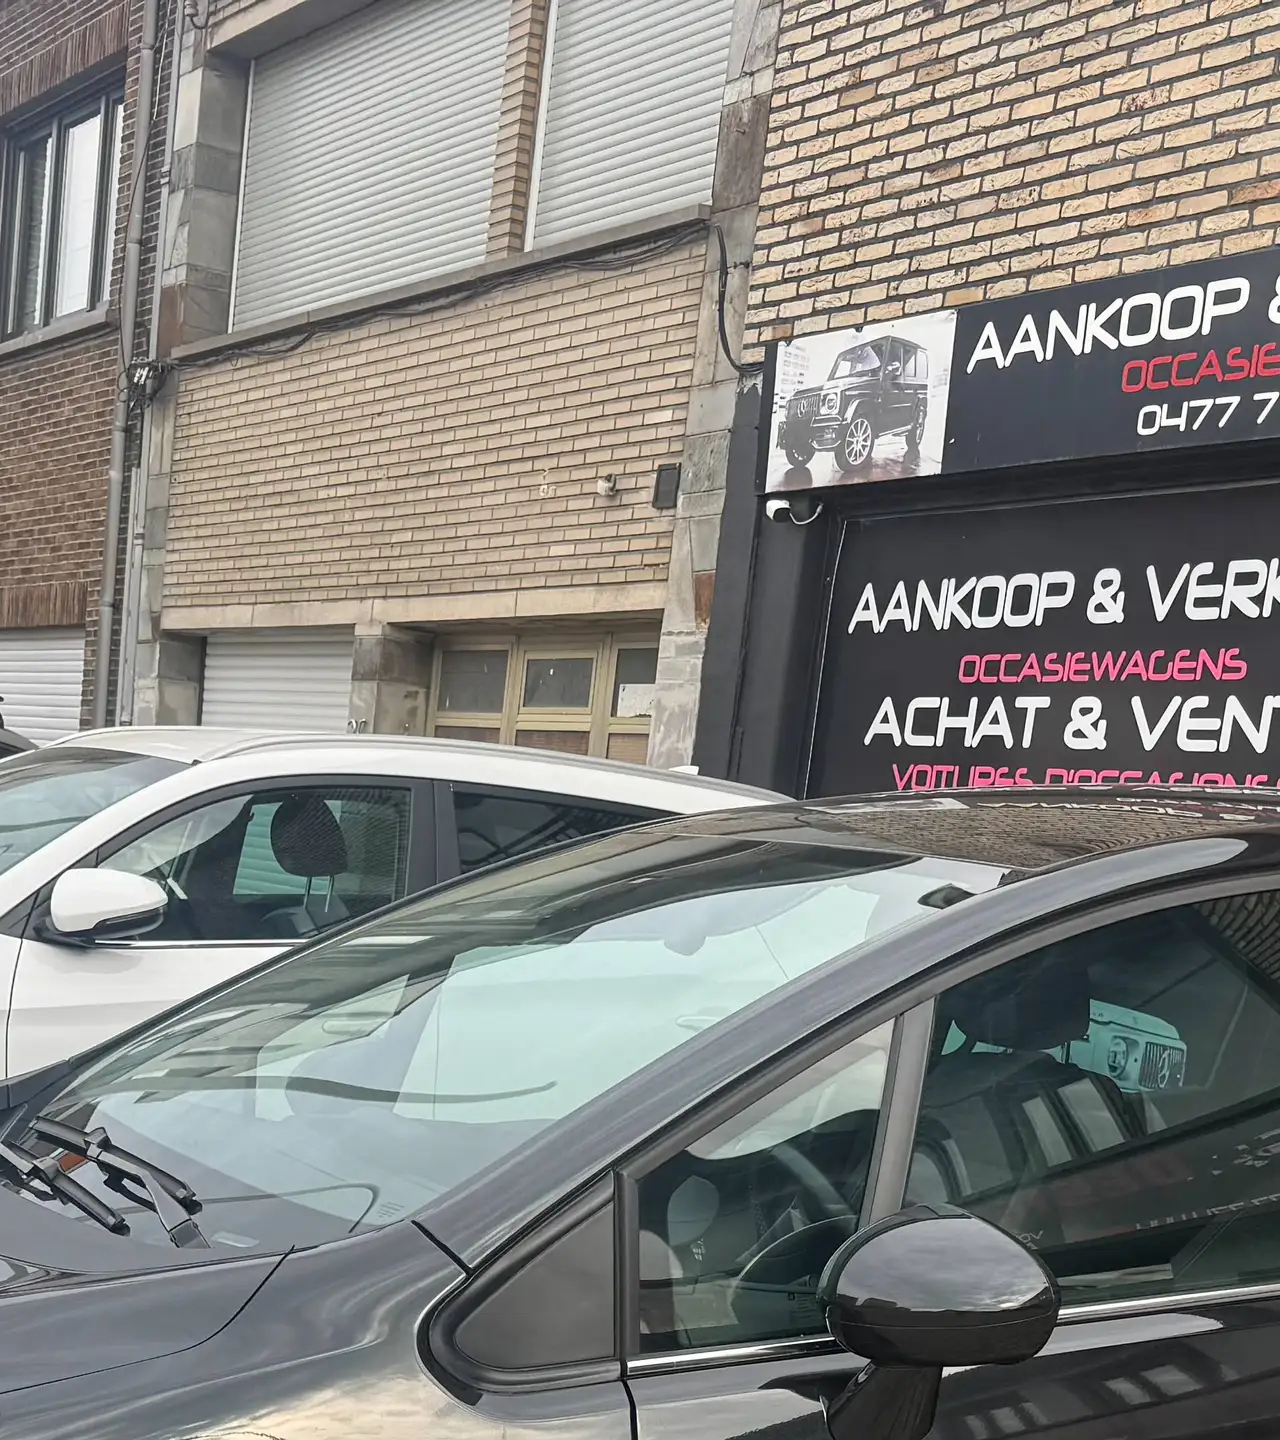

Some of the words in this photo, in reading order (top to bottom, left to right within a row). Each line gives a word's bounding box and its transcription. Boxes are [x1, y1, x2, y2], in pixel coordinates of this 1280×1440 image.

[966, 277, 1251, 374] AANKOOP
[1136, 395, 1241, 436] 0477
[847, 567, 1076, 634] AANKOOP
[1086, 567, 1125, 624] &
[957, 648, 1247, 684] OCCASIEWAGENS
[863, 695, 1051, 749] ACHAT
[1063, 695, 1107, 750] &
